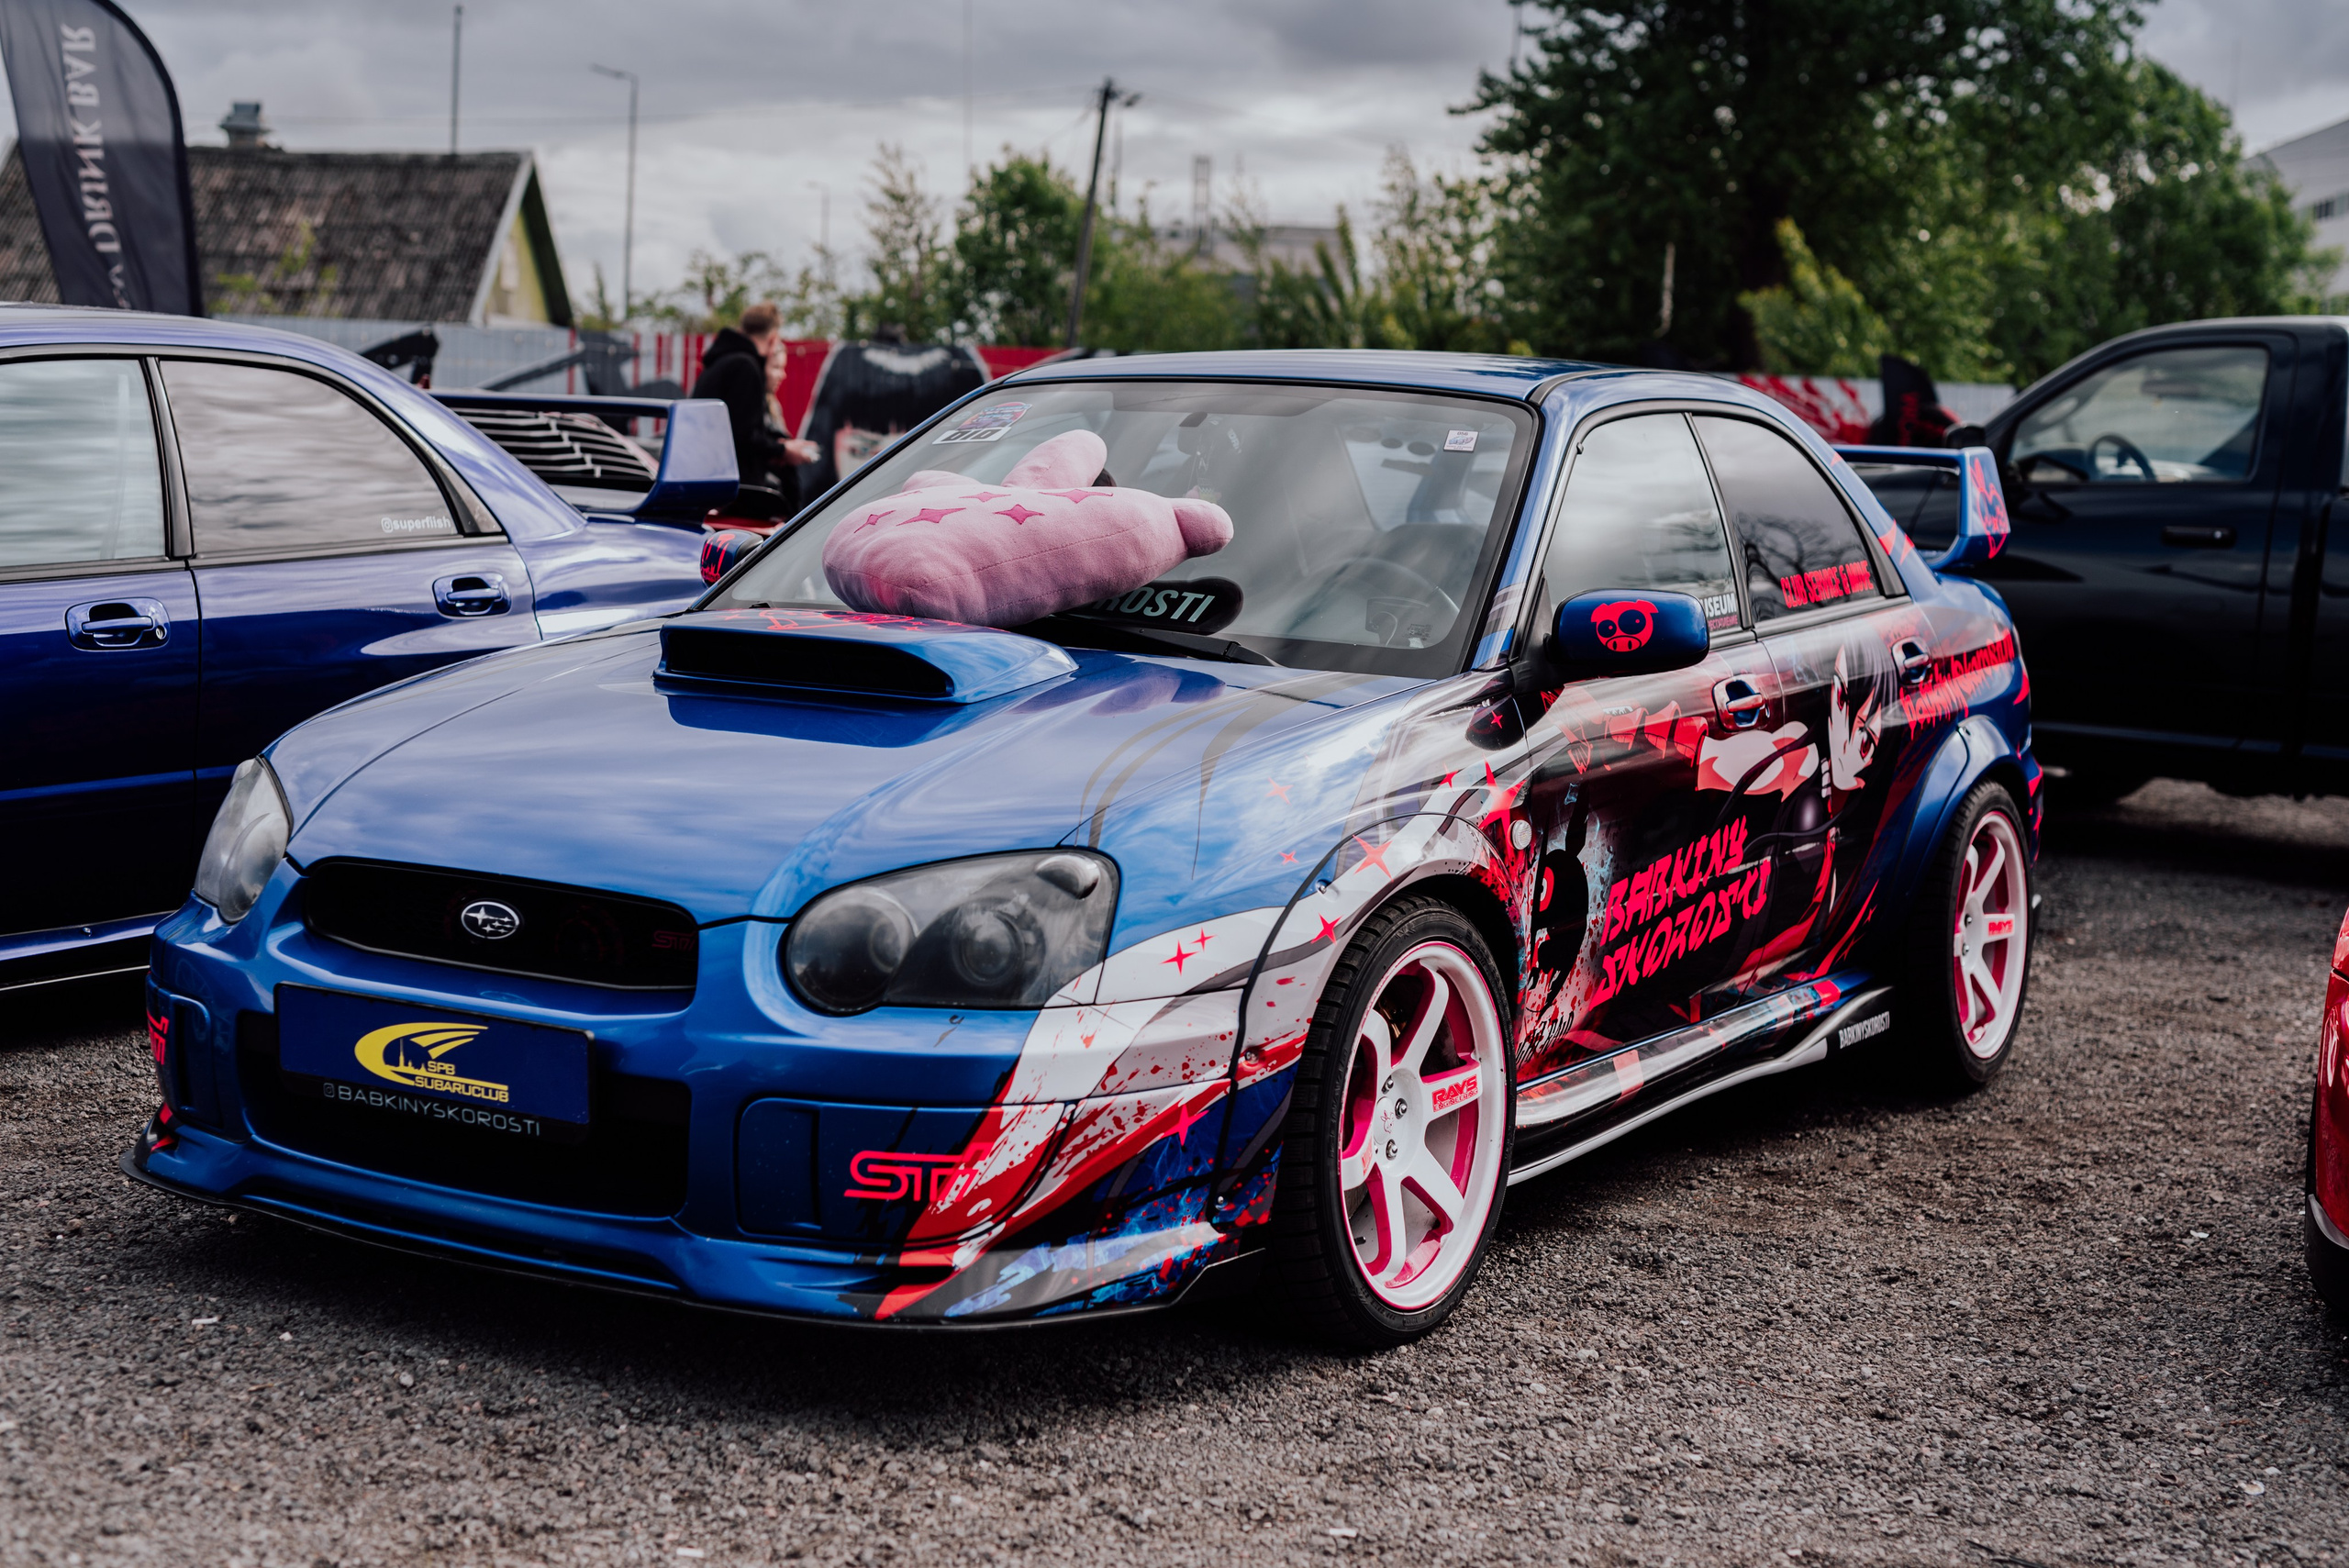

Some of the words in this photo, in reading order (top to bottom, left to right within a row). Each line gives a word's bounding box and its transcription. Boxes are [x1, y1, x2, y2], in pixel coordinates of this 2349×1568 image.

[1780, 573, 1809, 609] CLUB
[1803, 566, 1844, 604] SERVICE
[1599, 814, 1748, 948] BABKINY
[1588, 859, 1772, 1012] SKOROSTI
[1838, 1010, 1890, 1050] BABKINYSKOROSTI
[427, 1060, 456, 1076] SPB
[414, 1075, 510, 1103] SUBARUCLUB
[1431, 1073, 1477, 1105] RAYS
[1432, 1087, 1479, 1113] ENGINEERING
[338, 1084, 541, 1137] BABKINYSKOROSTI
